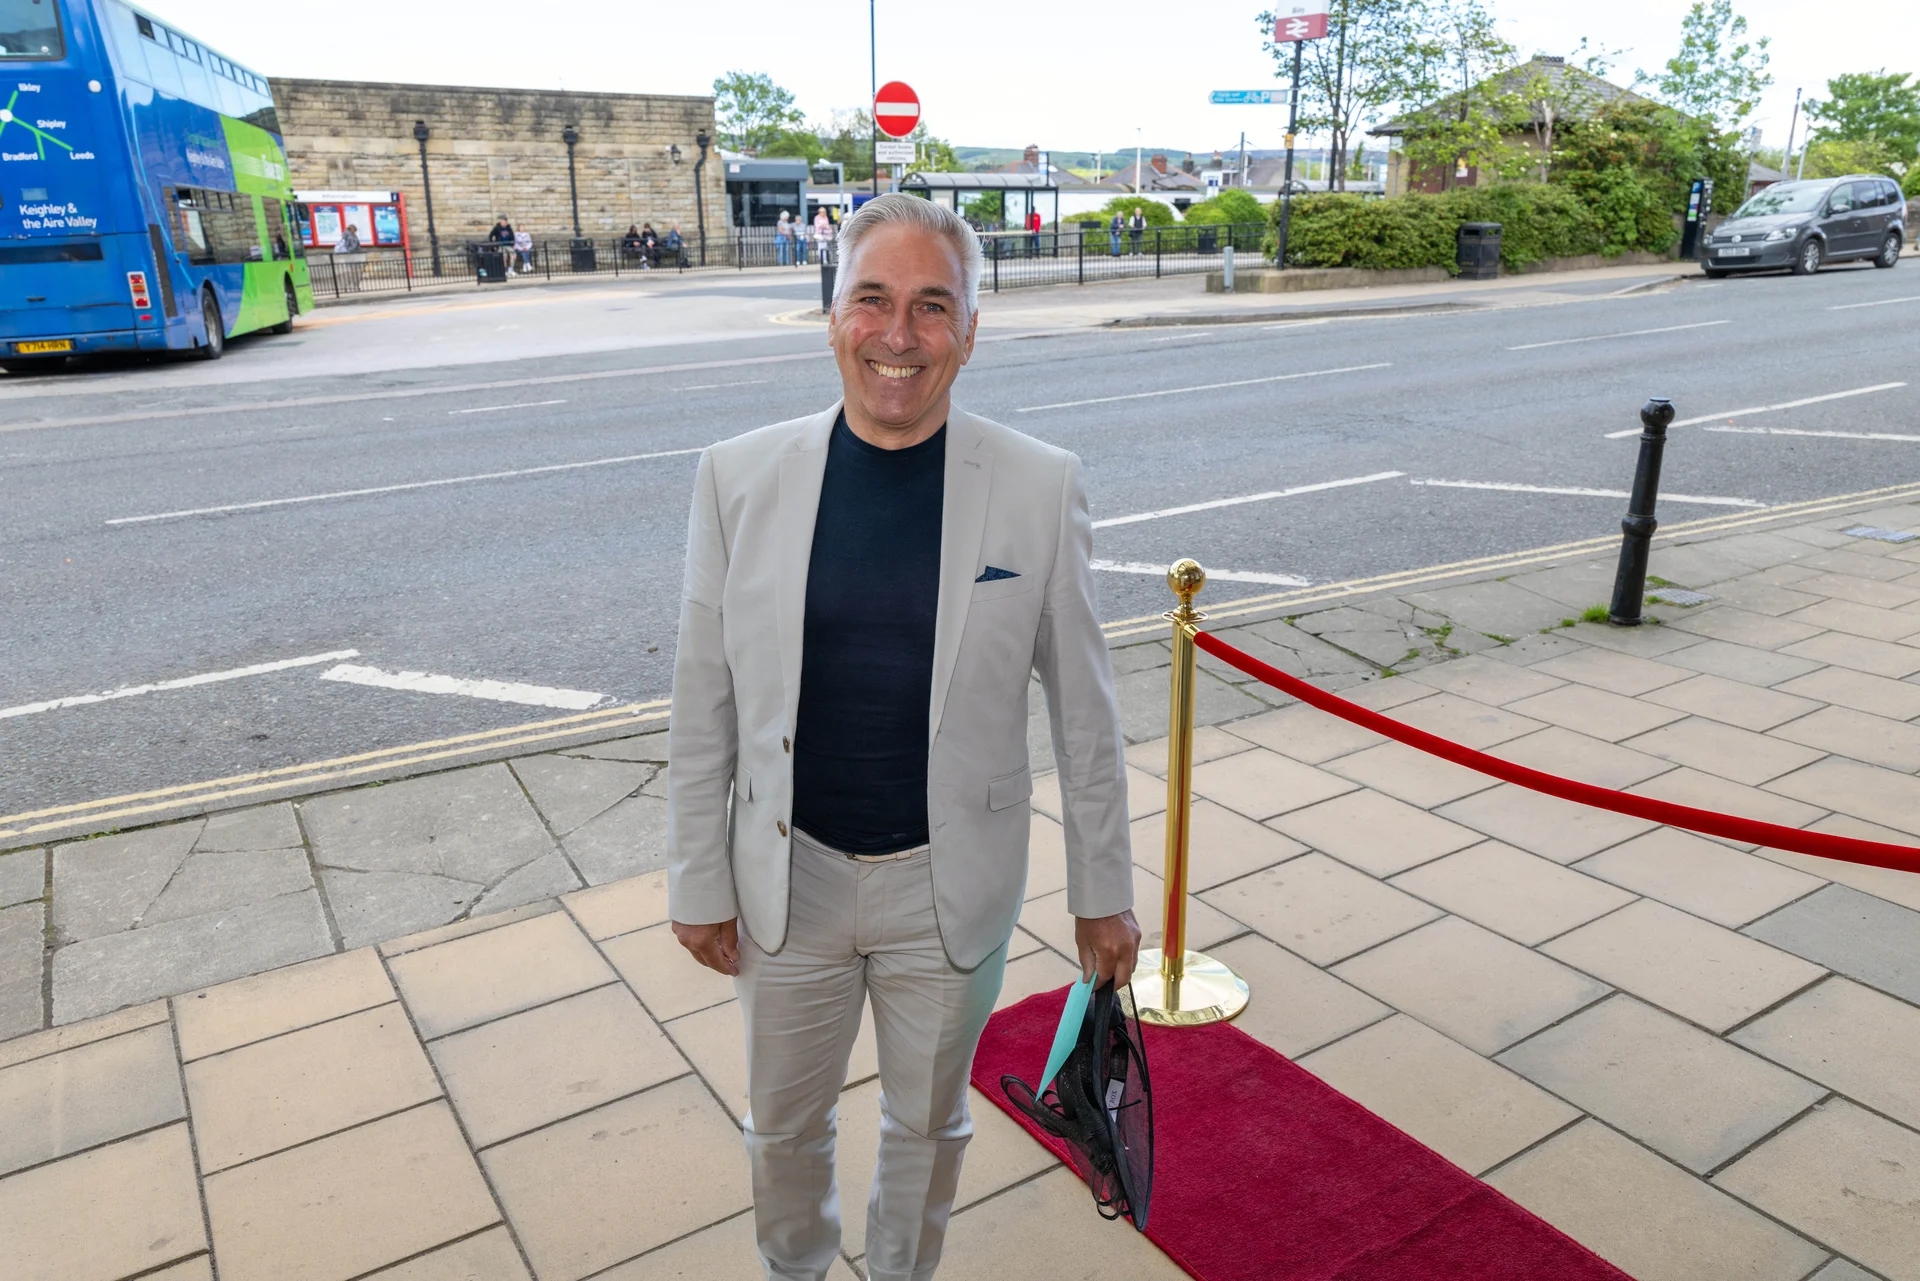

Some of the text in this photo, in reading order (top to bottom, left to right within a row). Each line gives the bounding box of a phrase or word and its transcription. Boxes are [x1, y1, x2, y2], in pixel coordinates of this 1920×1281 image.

[18, 82, 41, 93] Ilkley
[36, 119, 67, 130] Shipley
[1, 151, 39, 161] Bradford
[69, 151, 95, 160] Leeds
[19, 202, 78, 218] Keighley &
[22, 216, 97, 229] the Aire Valley
